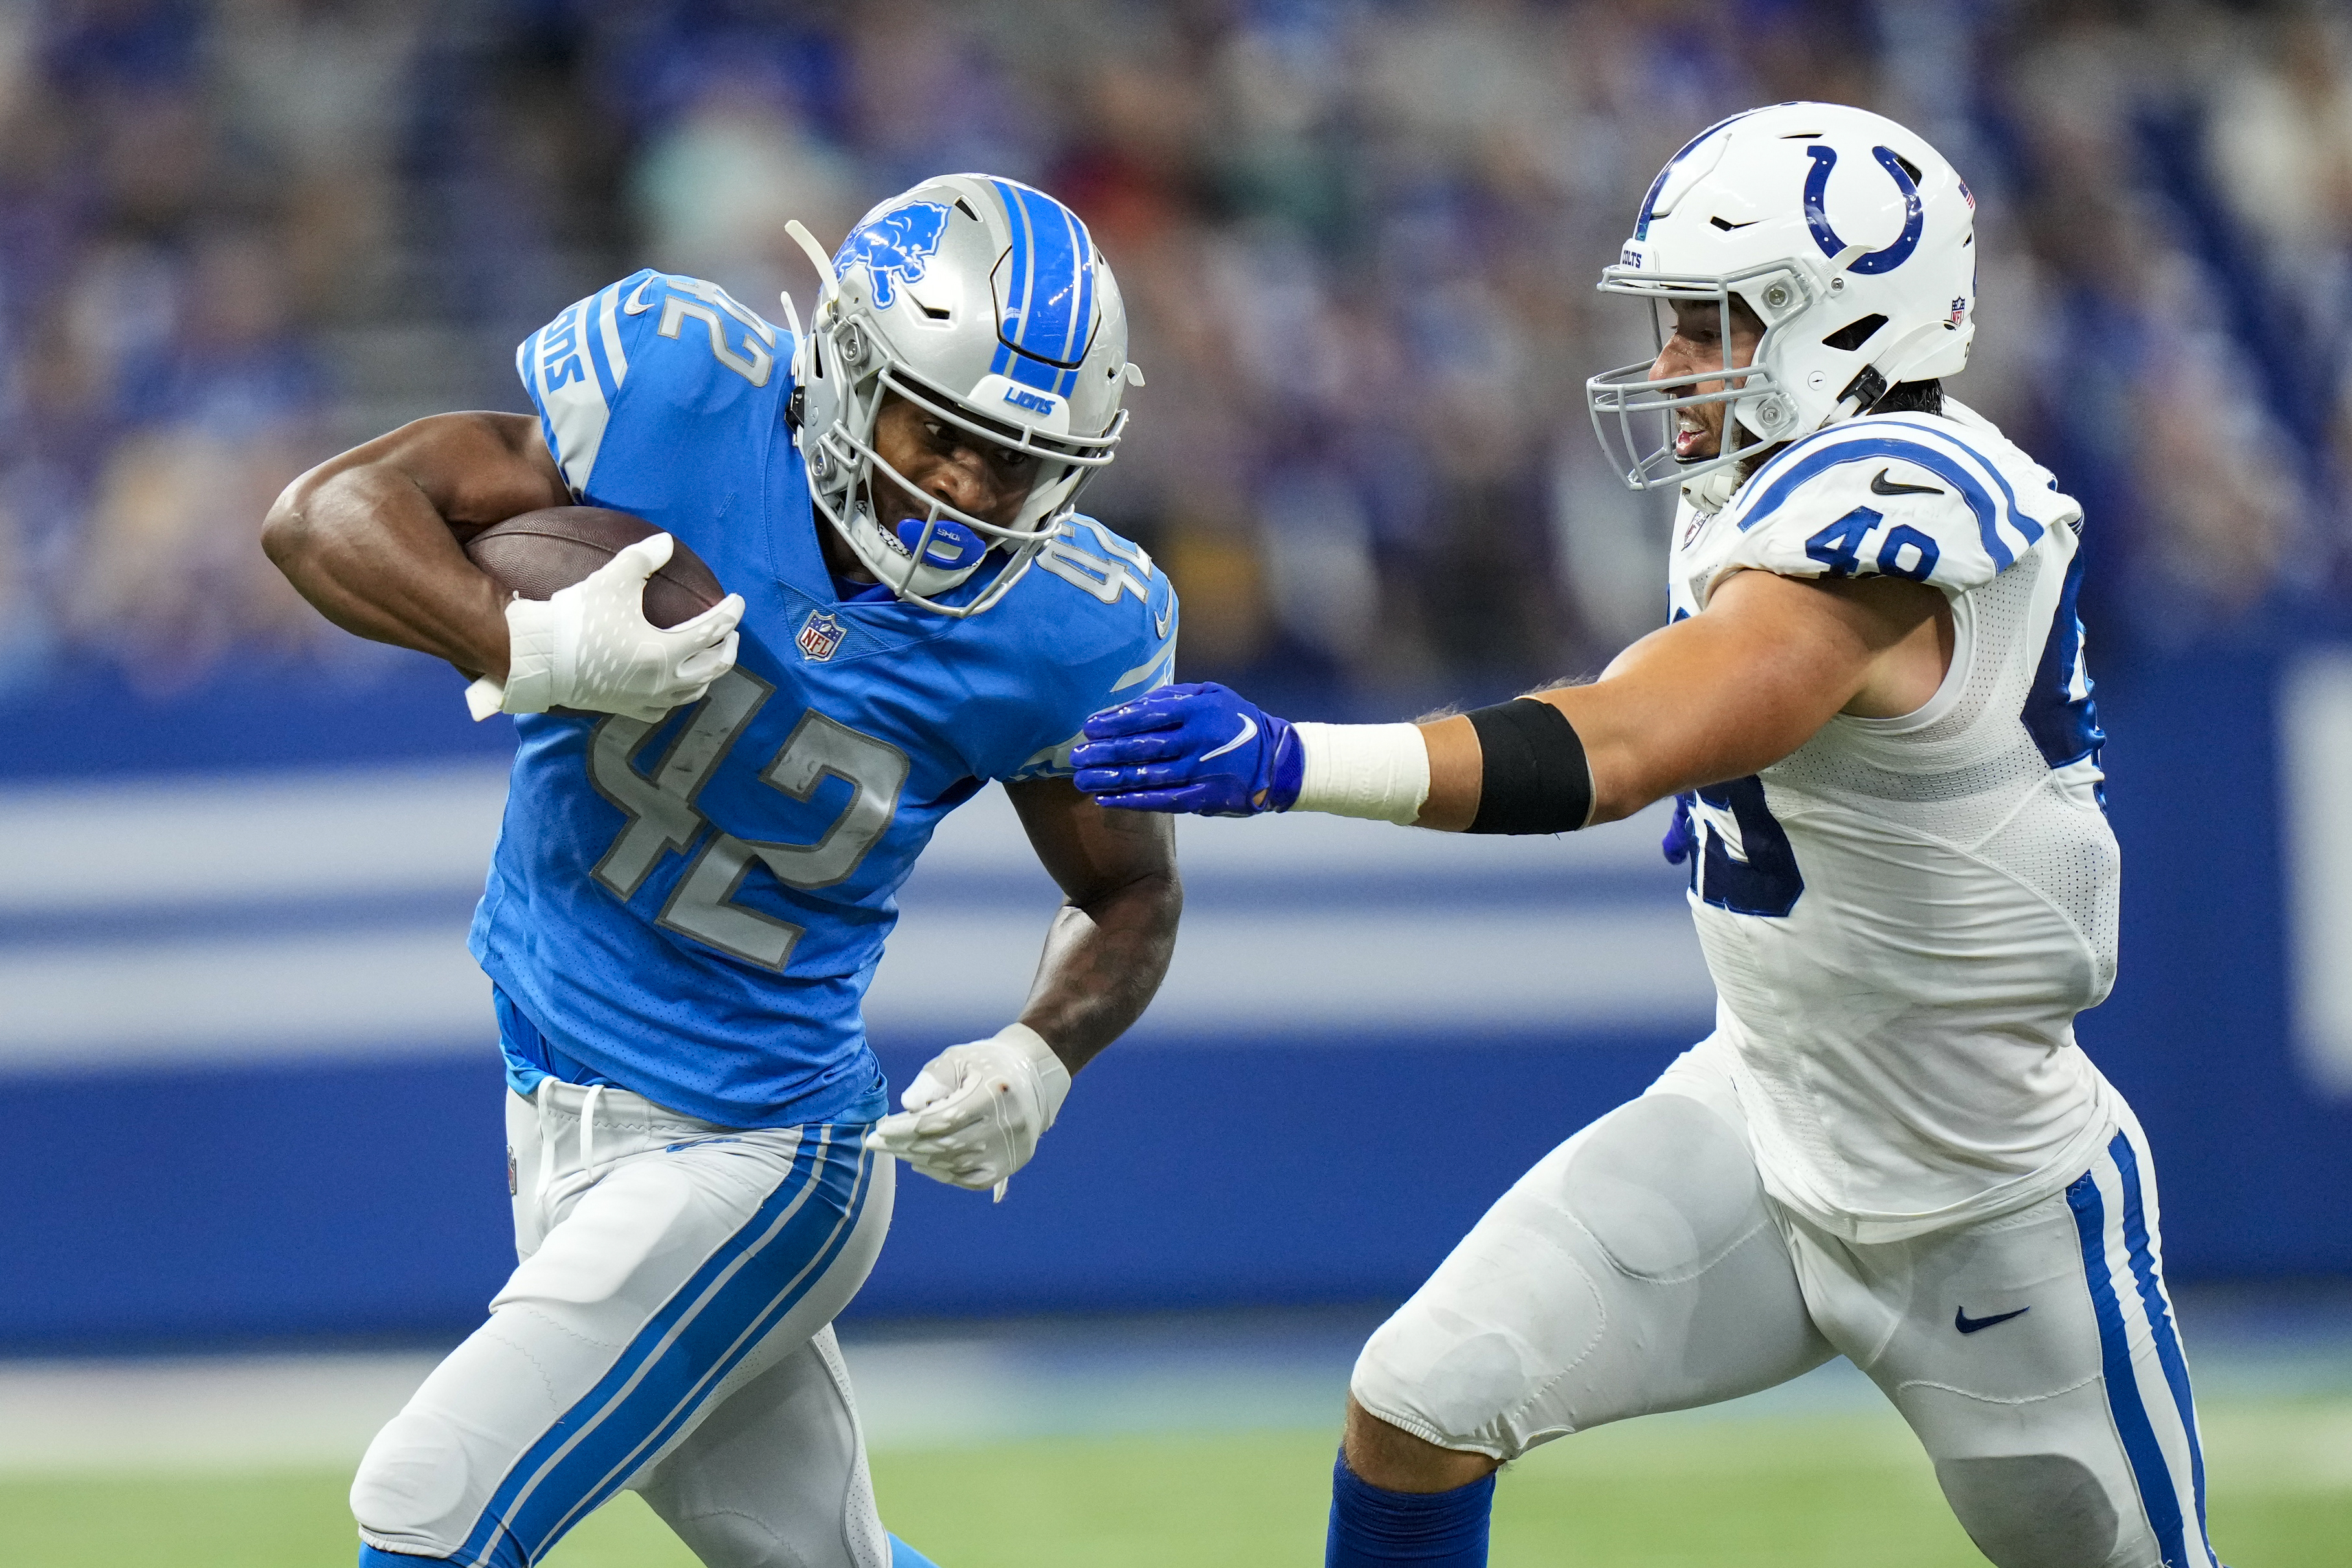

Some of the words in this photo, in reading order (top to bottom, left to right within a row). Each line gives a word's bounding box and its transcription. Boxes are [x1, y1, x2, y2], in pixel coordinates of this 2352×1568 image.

[1622, 249, 1642, 269] COLTS
[657, 278, 774, 387] 42
[1035, 516, 1152, 604] 42
[801, 629, 830, 655] NFL
[586, 662, 910, 973] 42
